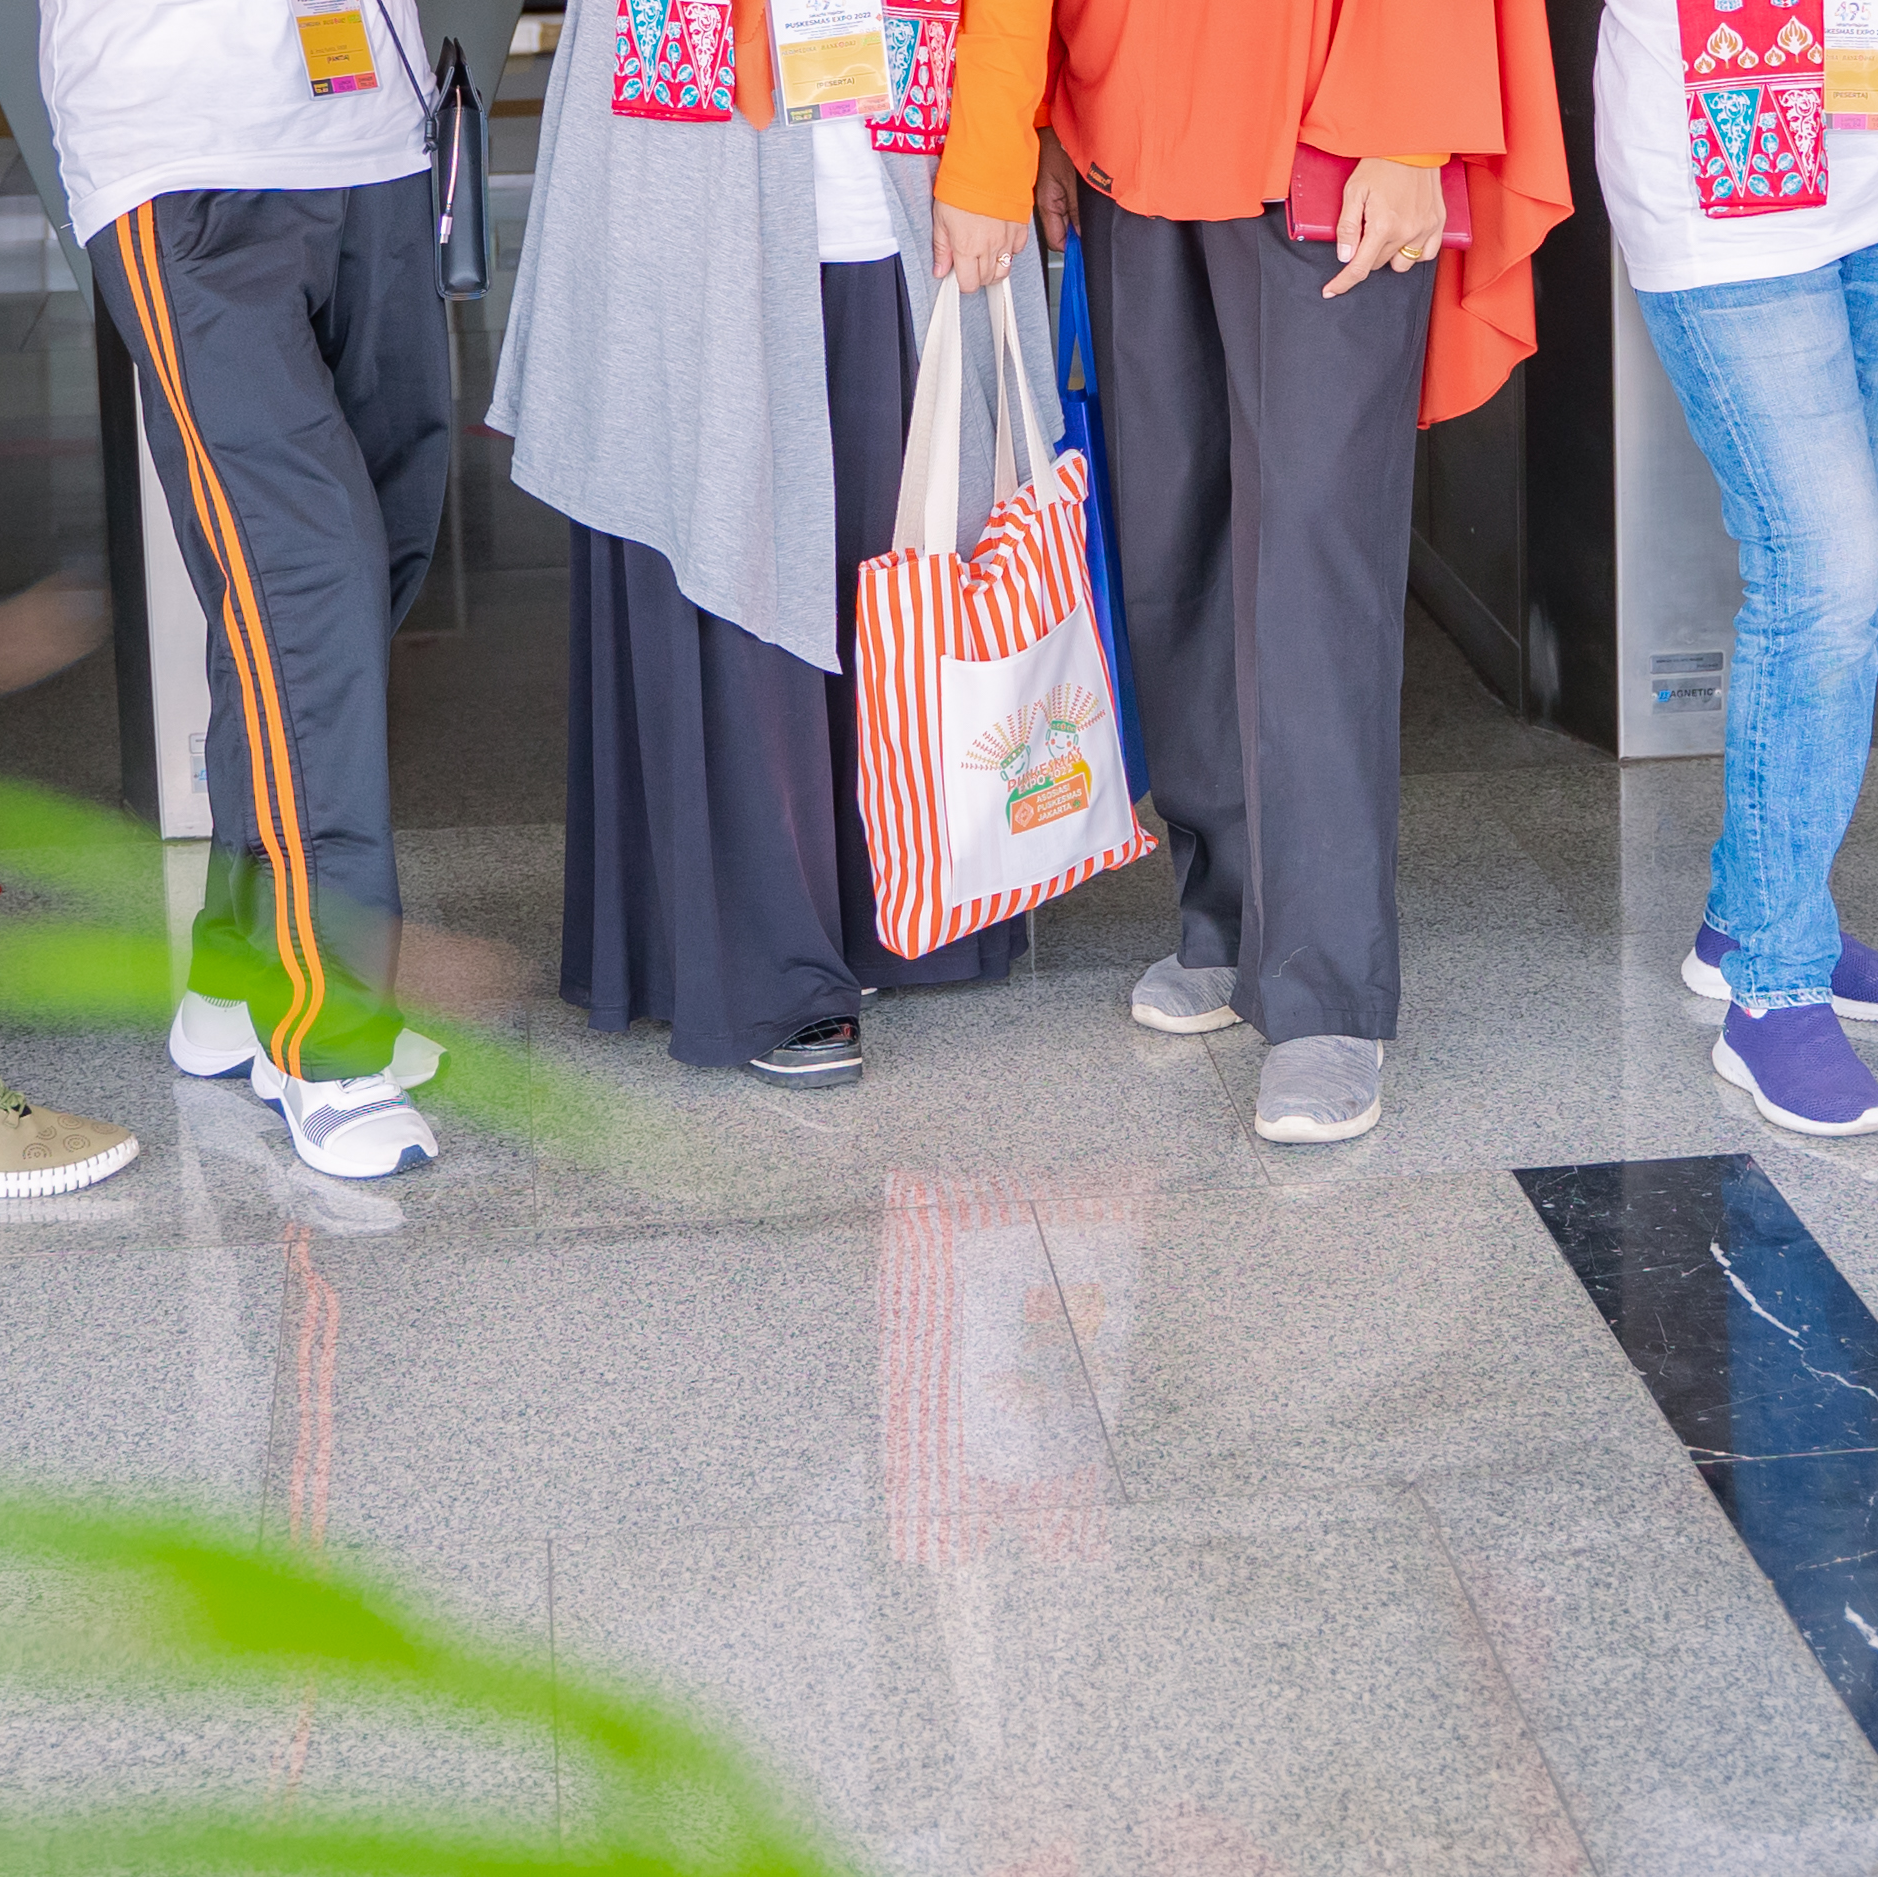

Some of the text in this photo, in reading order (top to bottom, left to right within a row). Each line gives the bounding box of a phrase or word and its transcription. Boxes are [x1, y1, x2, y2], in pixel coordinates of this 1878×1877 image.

[785, 18, 830, 30] PUSKESMAS
[832, 14, 852, 23] EXPO
[854, 11, 871, 20] 2022
[1824, 28, 1854, 36] SKESMAS
[817, 77, 855, 89] (PESERTA)
[1833, 92, 1868, 100] (PESERTA)
[1007, 746, 1083, 793] PUSKESMAS
[1019, 763, 1074, 795] EXPO 2022
[1036, 783, 1070, 802] ASOSIASI
[1037, 788, 1082, 812] PUSKESMAS
[1038, 803, 1072, 822] JAKARTA
